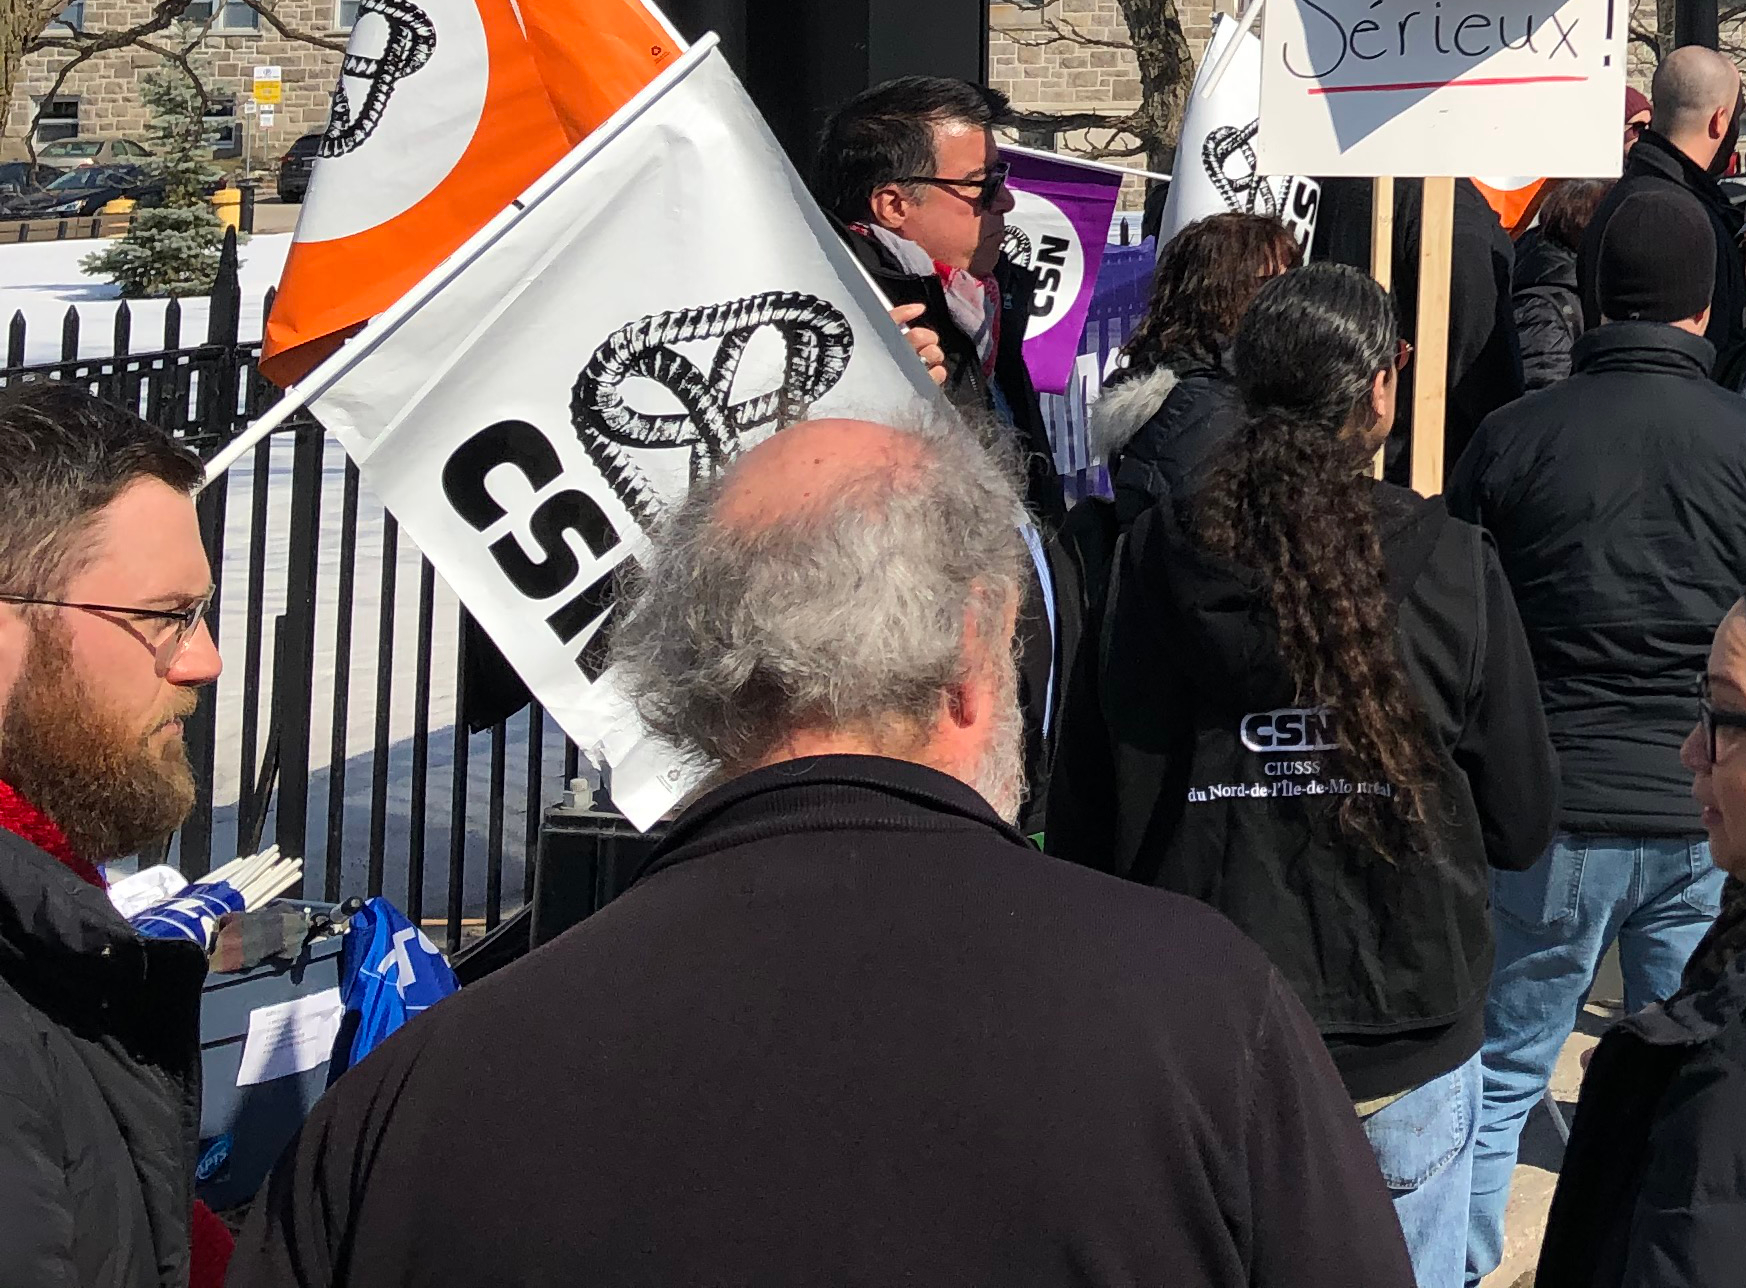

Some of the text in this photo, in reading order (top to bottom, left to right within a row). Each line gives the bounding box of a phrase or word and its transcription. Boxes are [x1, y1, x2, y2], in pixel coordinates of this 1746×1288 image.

[1027, 235, 1070, 317] CSN
[1244, 713, 1338, 748] CSN
[1264, 761, 1321, 776] CIUSSS
[1188, 787, 1206, 803] du
